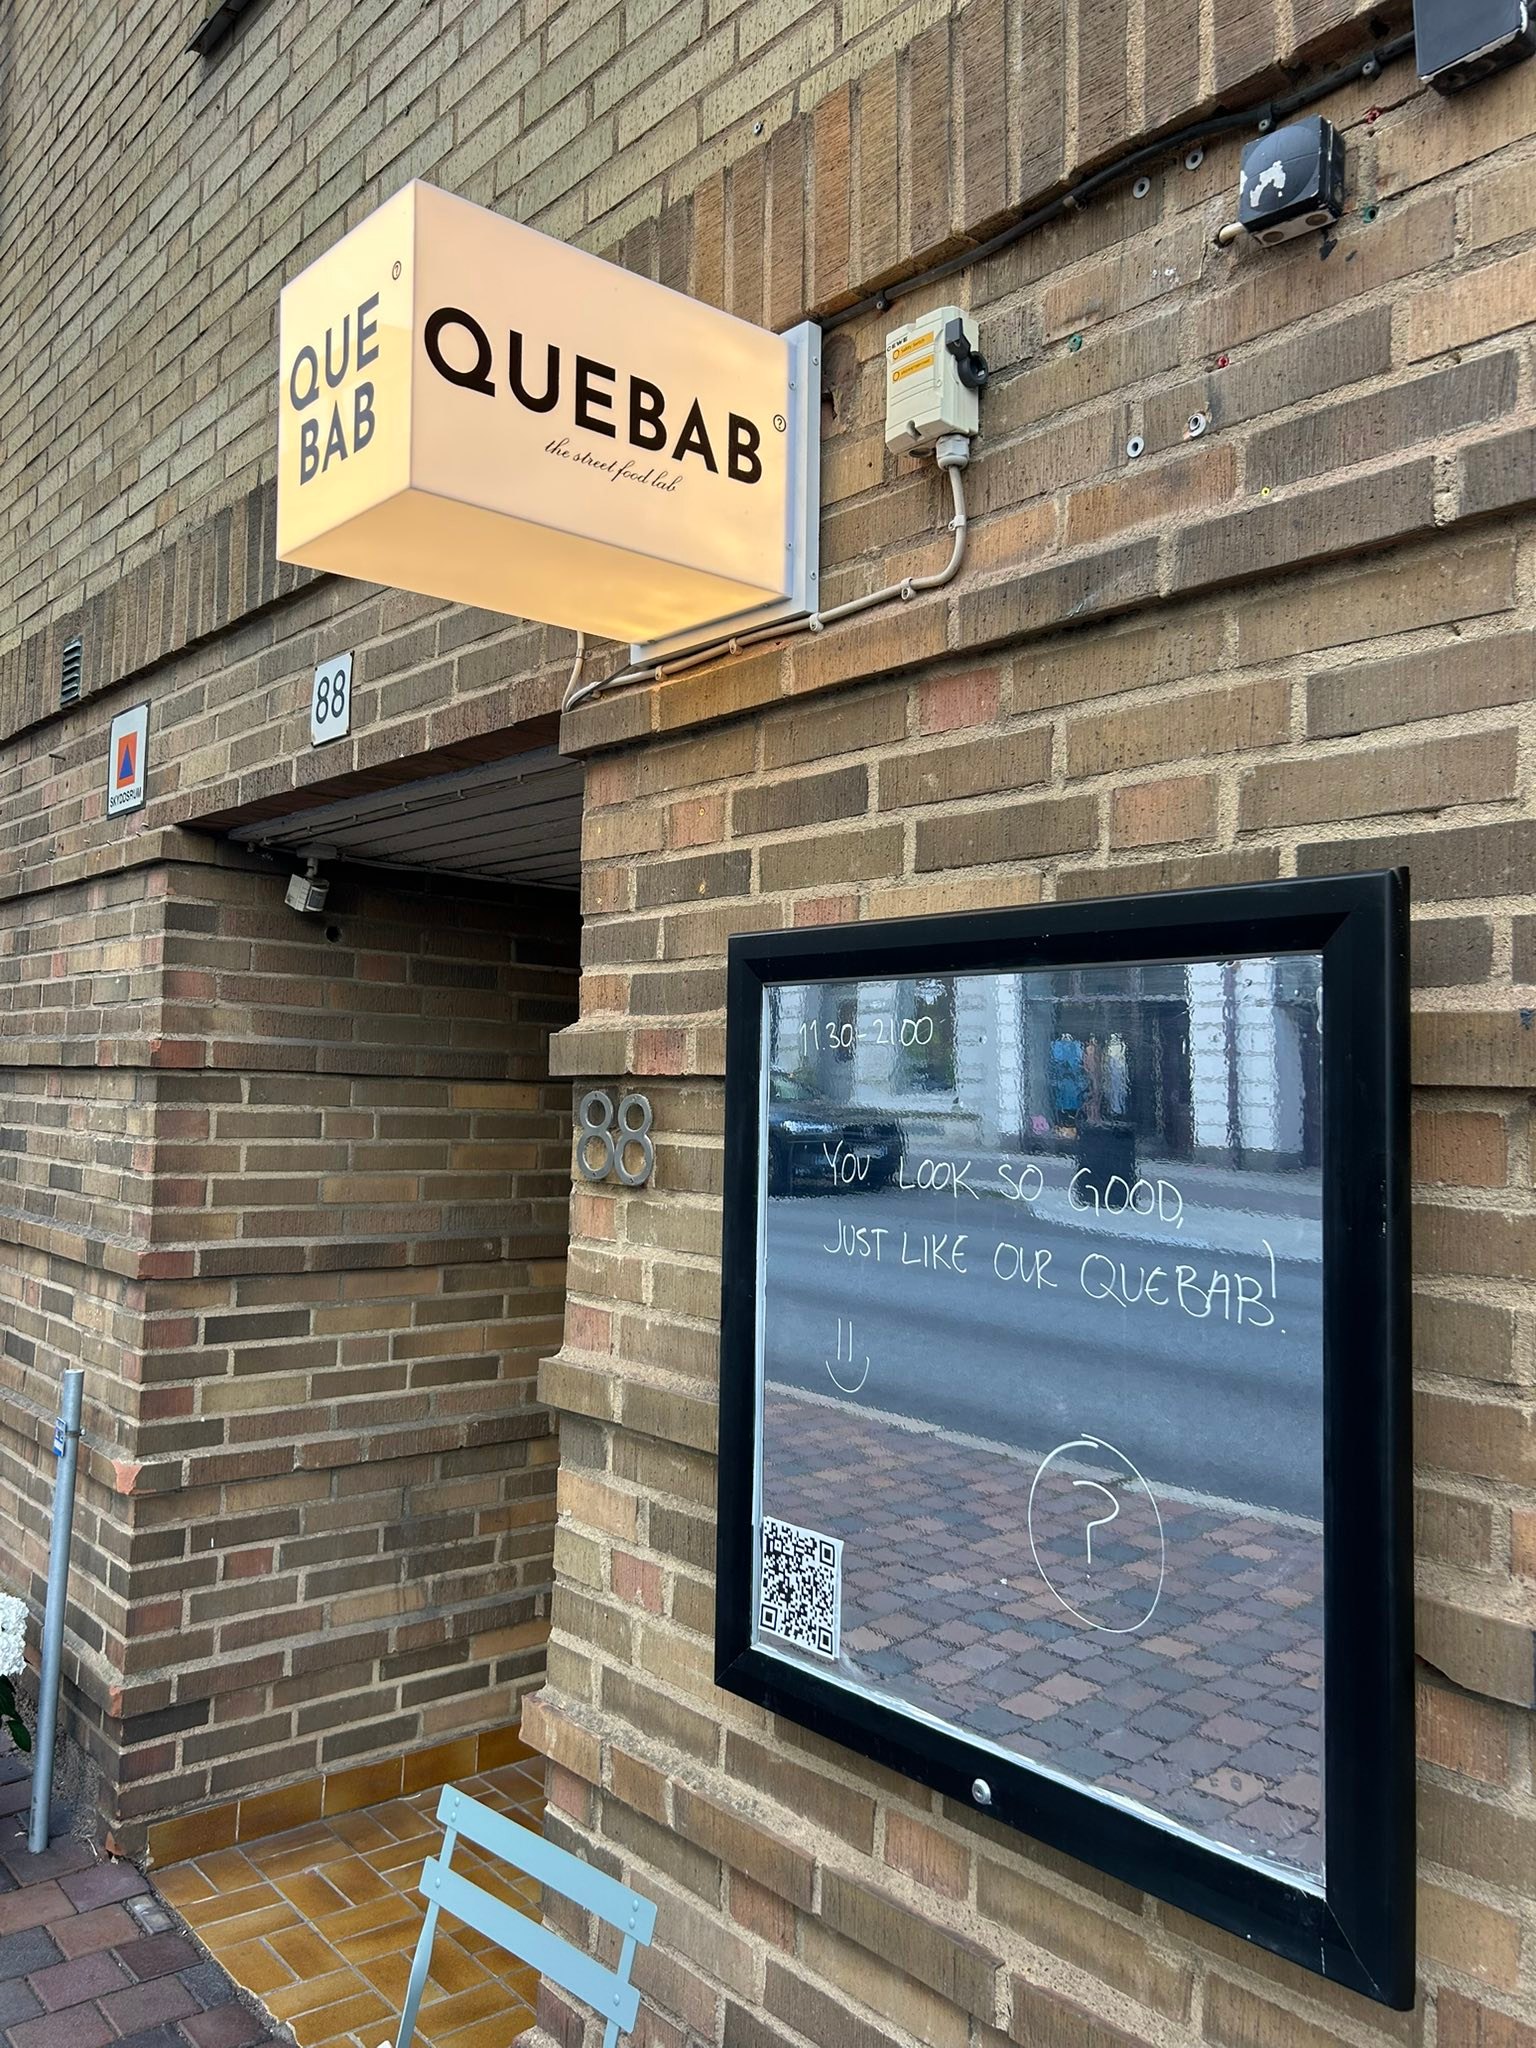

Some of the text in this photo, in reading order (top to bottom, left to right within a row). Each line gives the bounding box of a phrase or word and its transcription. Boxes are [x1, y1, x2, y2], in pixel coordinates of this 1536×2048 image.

[290, 292, 380, 412] QUE
[887, 336, 908, 352] CEWE
[300, 381, 376, 486] BAB
[424, 307, 763, 485] QUEBAB
[544, 437, 684, 492] the street food lab
[315, 669, 346, 725] 88
[576, 1090, 654, 1187] 88
[823, 1140, 1184, 1230] YOU LOOK SO GOOD,
[823, 1218, 889, 1261] JUST
[901, 1231, 969, 1274] LIKE
[994, 1242, 1058, 1289] OUR
